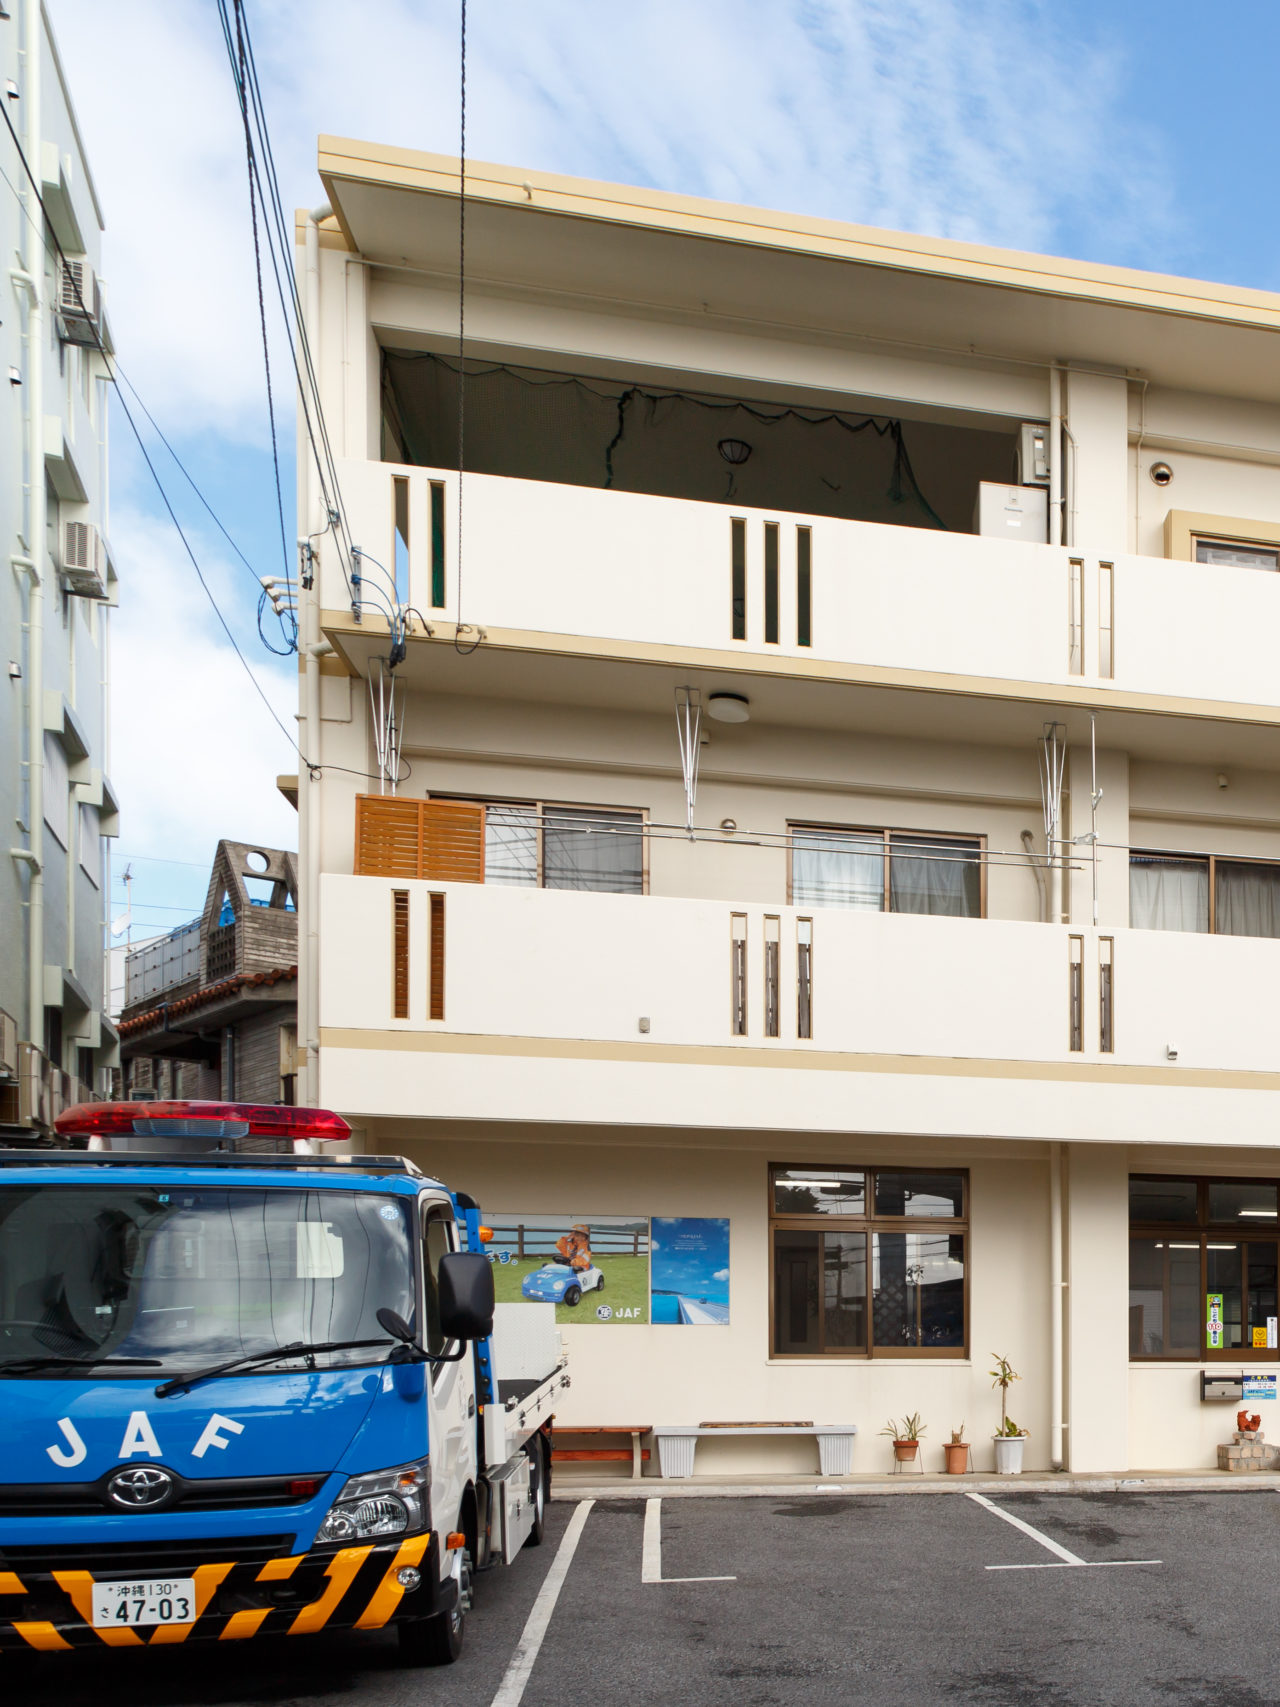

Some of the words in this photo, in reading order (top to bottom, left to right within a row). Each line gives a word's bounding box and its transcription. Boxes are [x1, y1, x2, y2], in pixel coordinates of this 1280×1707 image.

[615, 1307, 641, 1318] JAF
[46, 1411, 245, 1468] JAF
[100, 1606, 109, 1619] さ
[115, 1597, 189, 1623] 47-03
